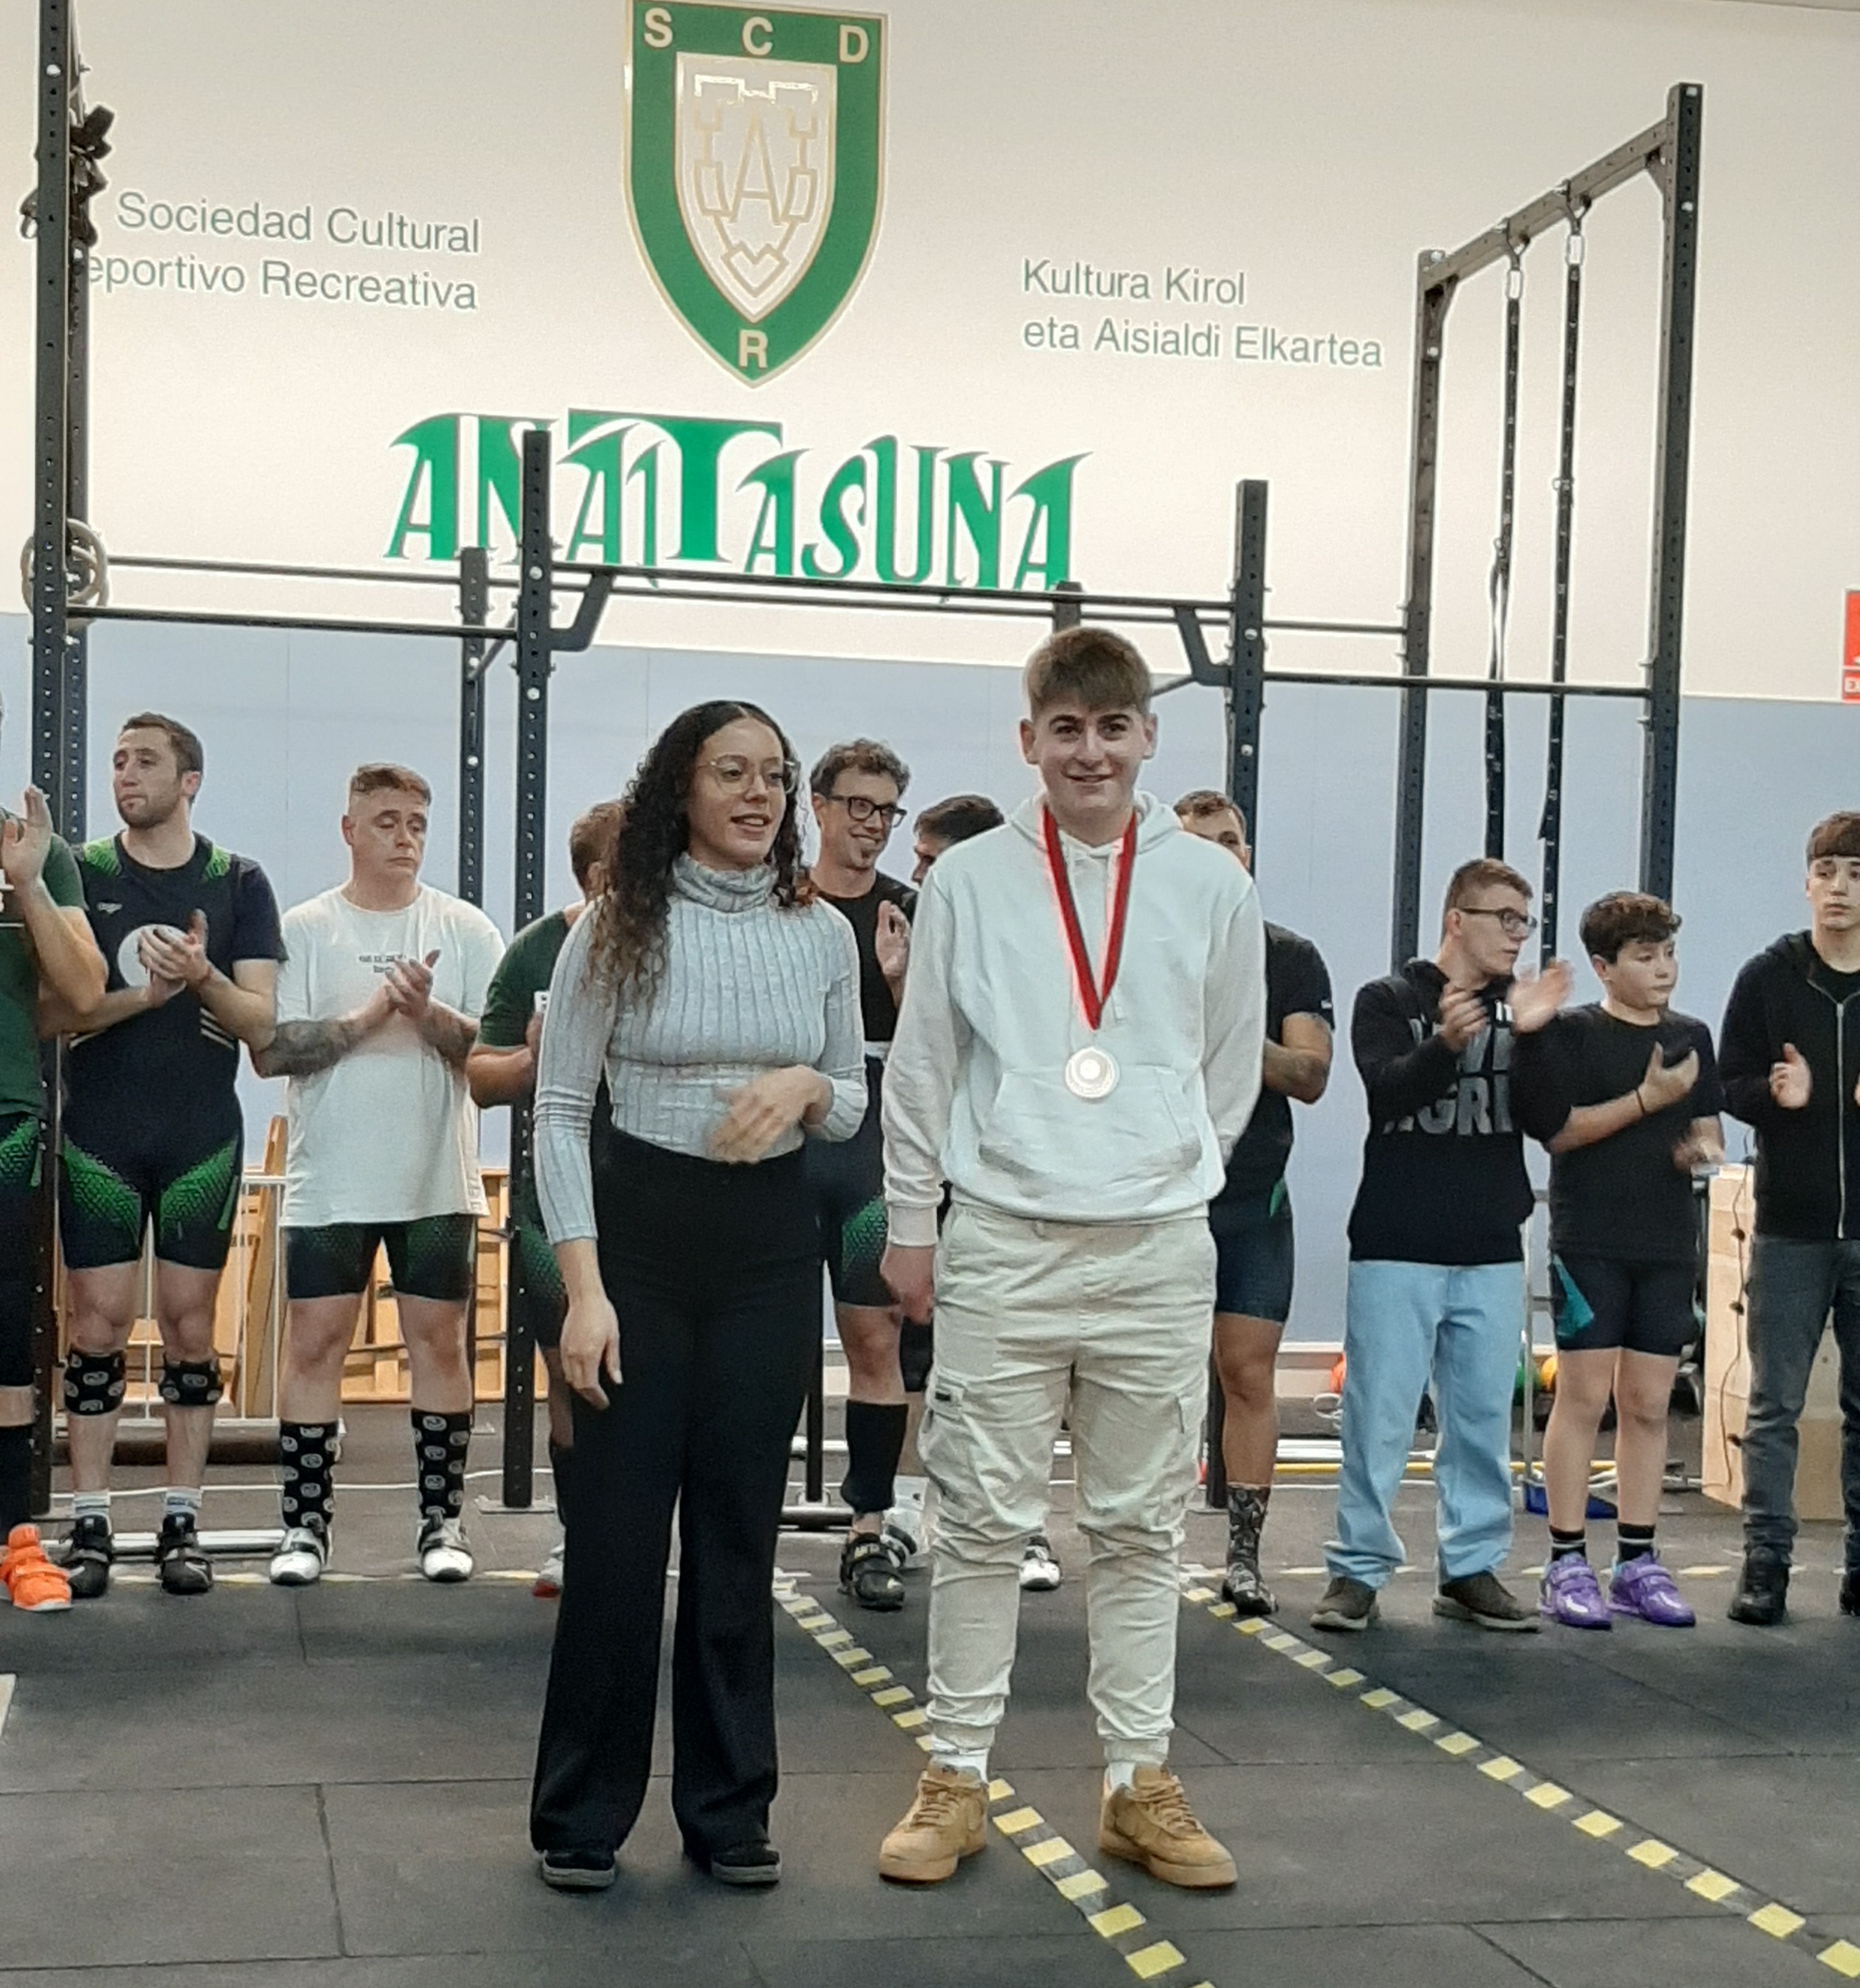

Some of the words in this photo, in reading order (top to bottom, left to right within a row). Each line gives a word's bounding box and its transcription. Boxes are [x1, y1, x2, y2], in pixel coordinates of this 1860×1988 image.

[644, 9, 672, 48] S
[742, 17, 773, 55] C
[839, 25, 868, 63] D
[117, 191, 311, 241] Sociedad
[327, 207, 479, 253] Cultural
[90, 253, 245, 293] eportivo
[263, 260, 477, 310] Recreativa
[1024, 258, 1151, 300] Kultura
[1166, 266, 1244, 304] Kirol
[739, 330, 767, 368] R
[1023, 317, 1080, 350] eta
[1094, 317, 1220, 357] Aisialdi
[1235, 325, 1382, 367] Elkartea
